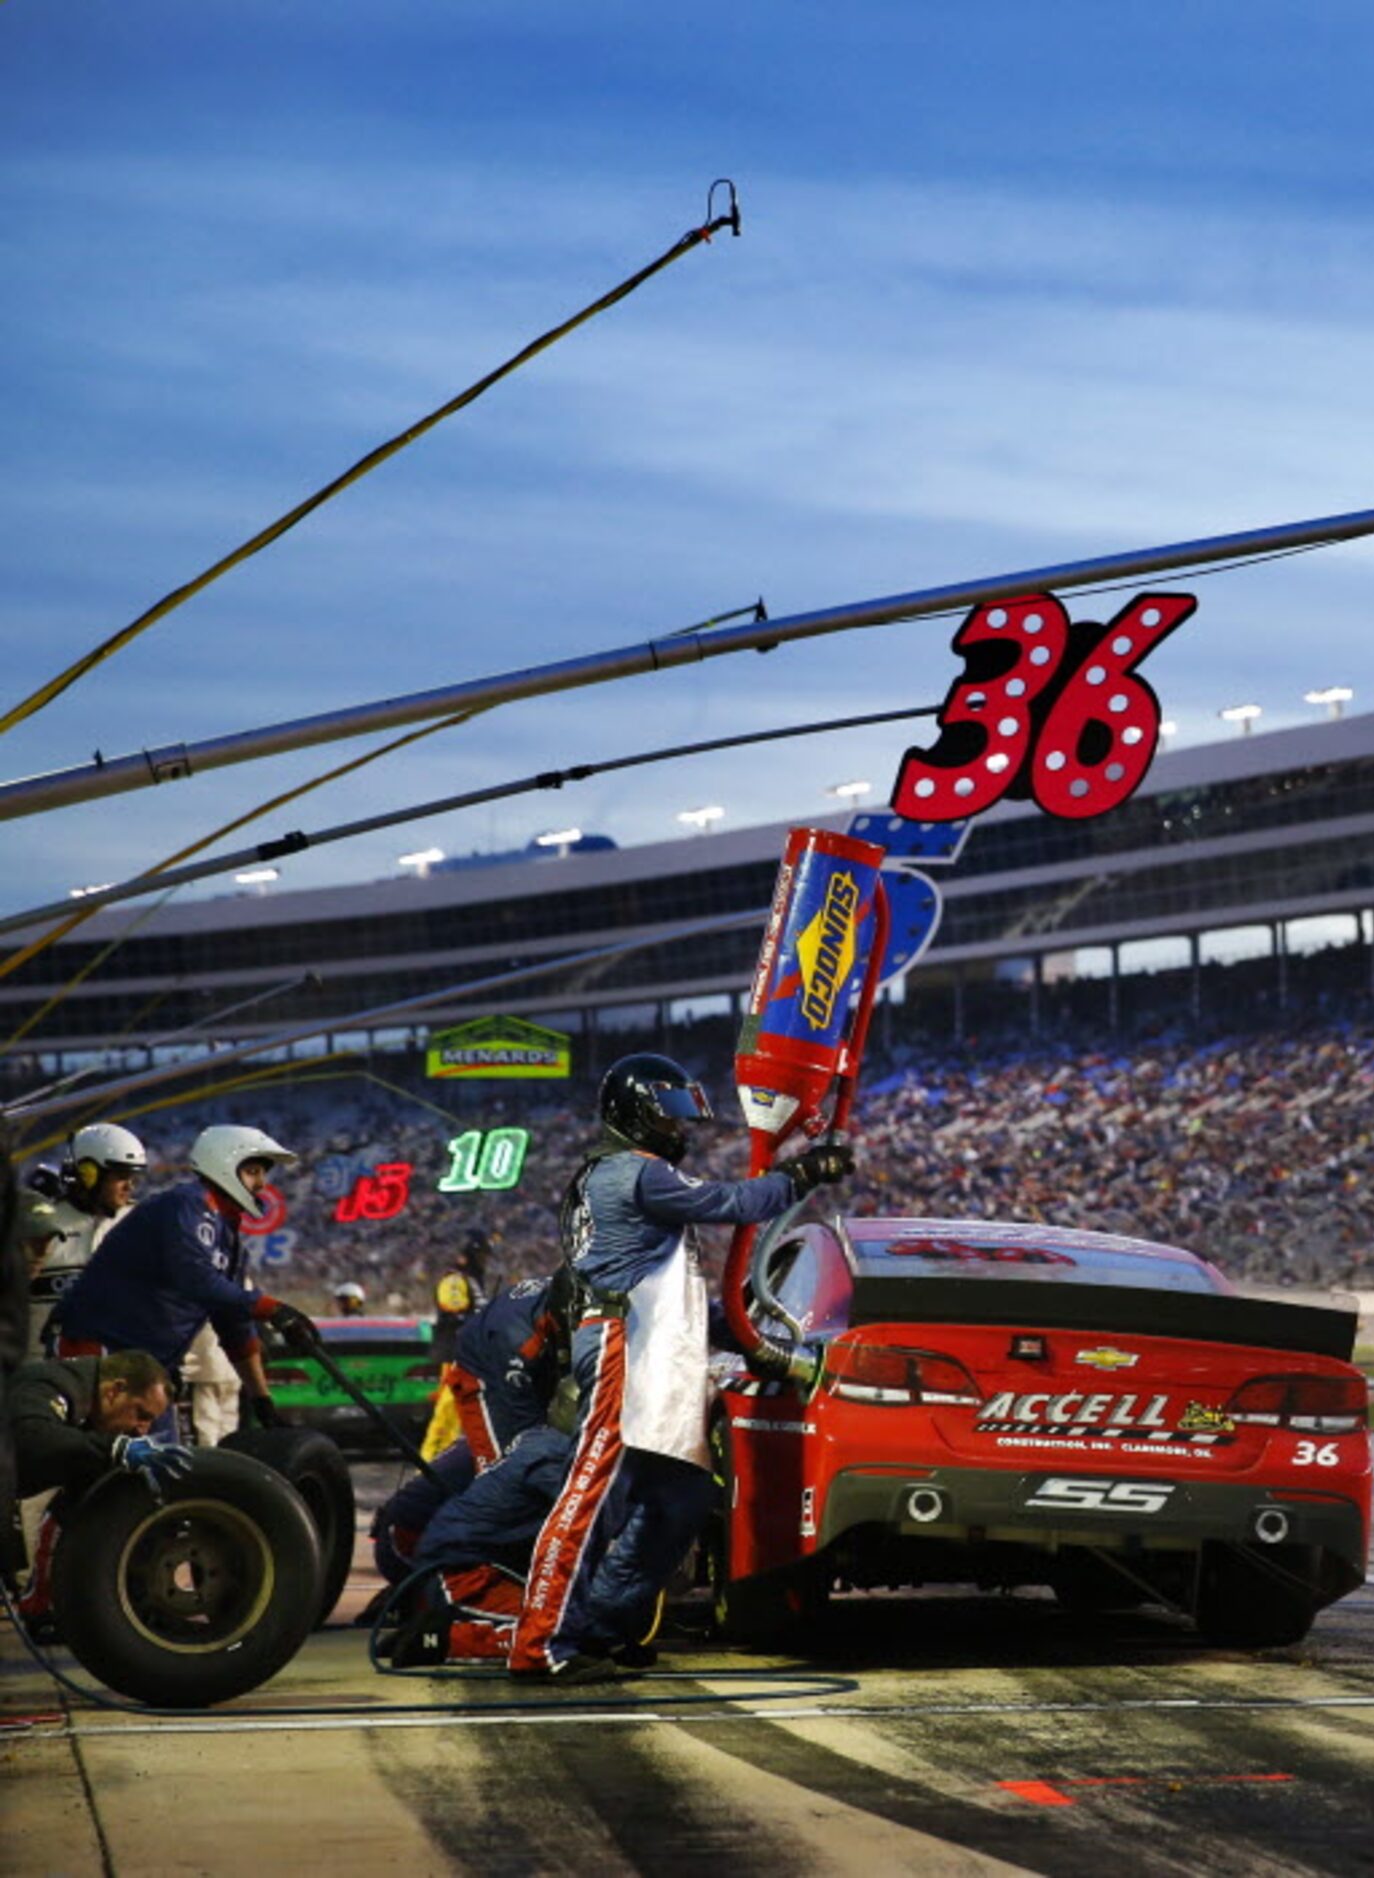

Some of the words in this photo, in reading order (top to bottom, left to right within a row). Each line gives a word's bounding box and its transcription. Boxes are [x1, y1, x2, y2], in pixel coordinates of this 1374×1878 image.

[892, 592, 1197, 822] 36
[804, 873, 858, 1025] SUNOCO
[441, 1050, 557, 1064] MENARDS
[438, 1128, 528, 1191] 10
[335, 1161, 411, 1223] 15
[976, 1391, 1169, 1426] ACCELL
[1292, 1440, 1339, 1467] 36
[1025, 1477, 1176, 1513] SS
